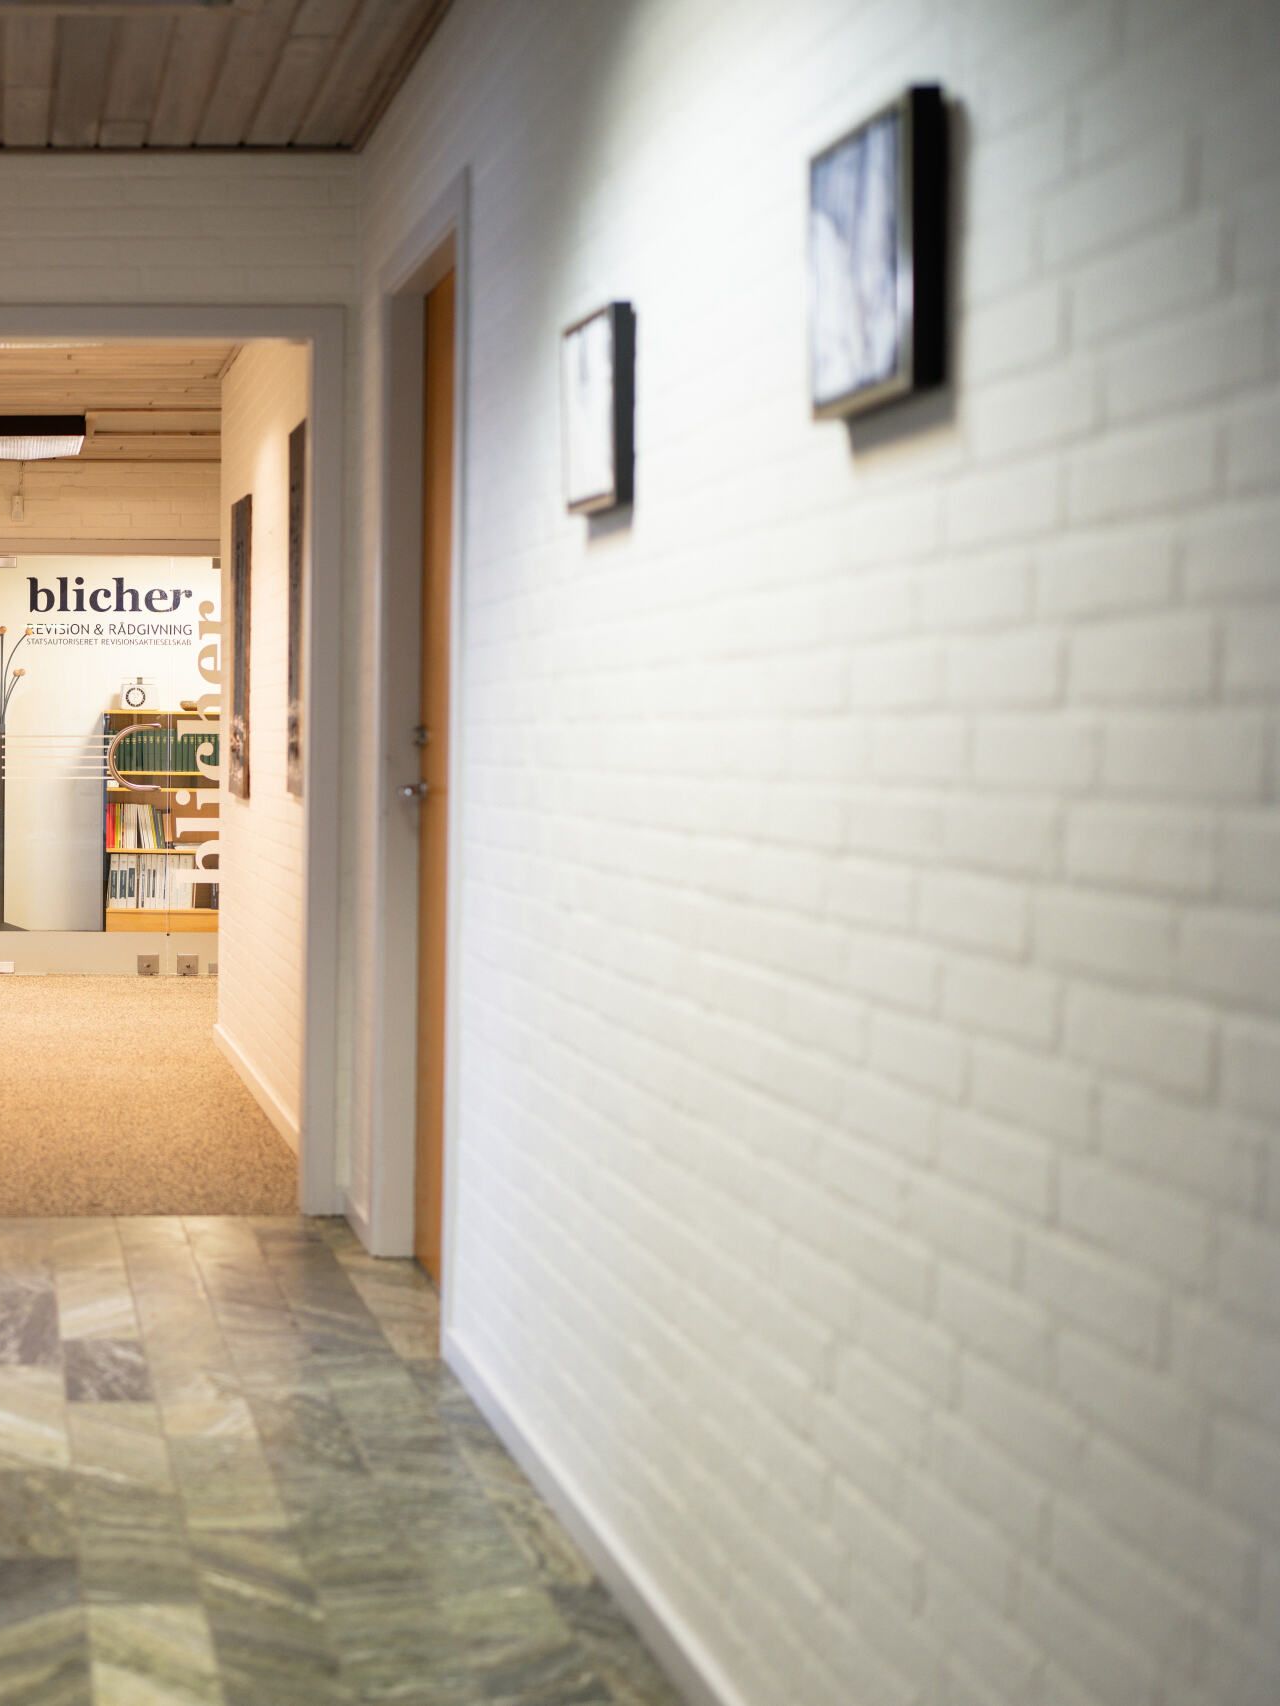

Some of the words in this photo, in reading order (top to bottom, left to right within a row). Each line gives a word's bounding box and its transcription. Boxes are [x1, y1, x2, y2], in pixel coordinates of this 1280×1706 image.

[26, 577, 193, 613] blicher
[94, 623, 104, 635] &
[109, 621, 193, 636] RÅDGIVNING
[26, 638, 98, 646] STATSAUTORISERET
